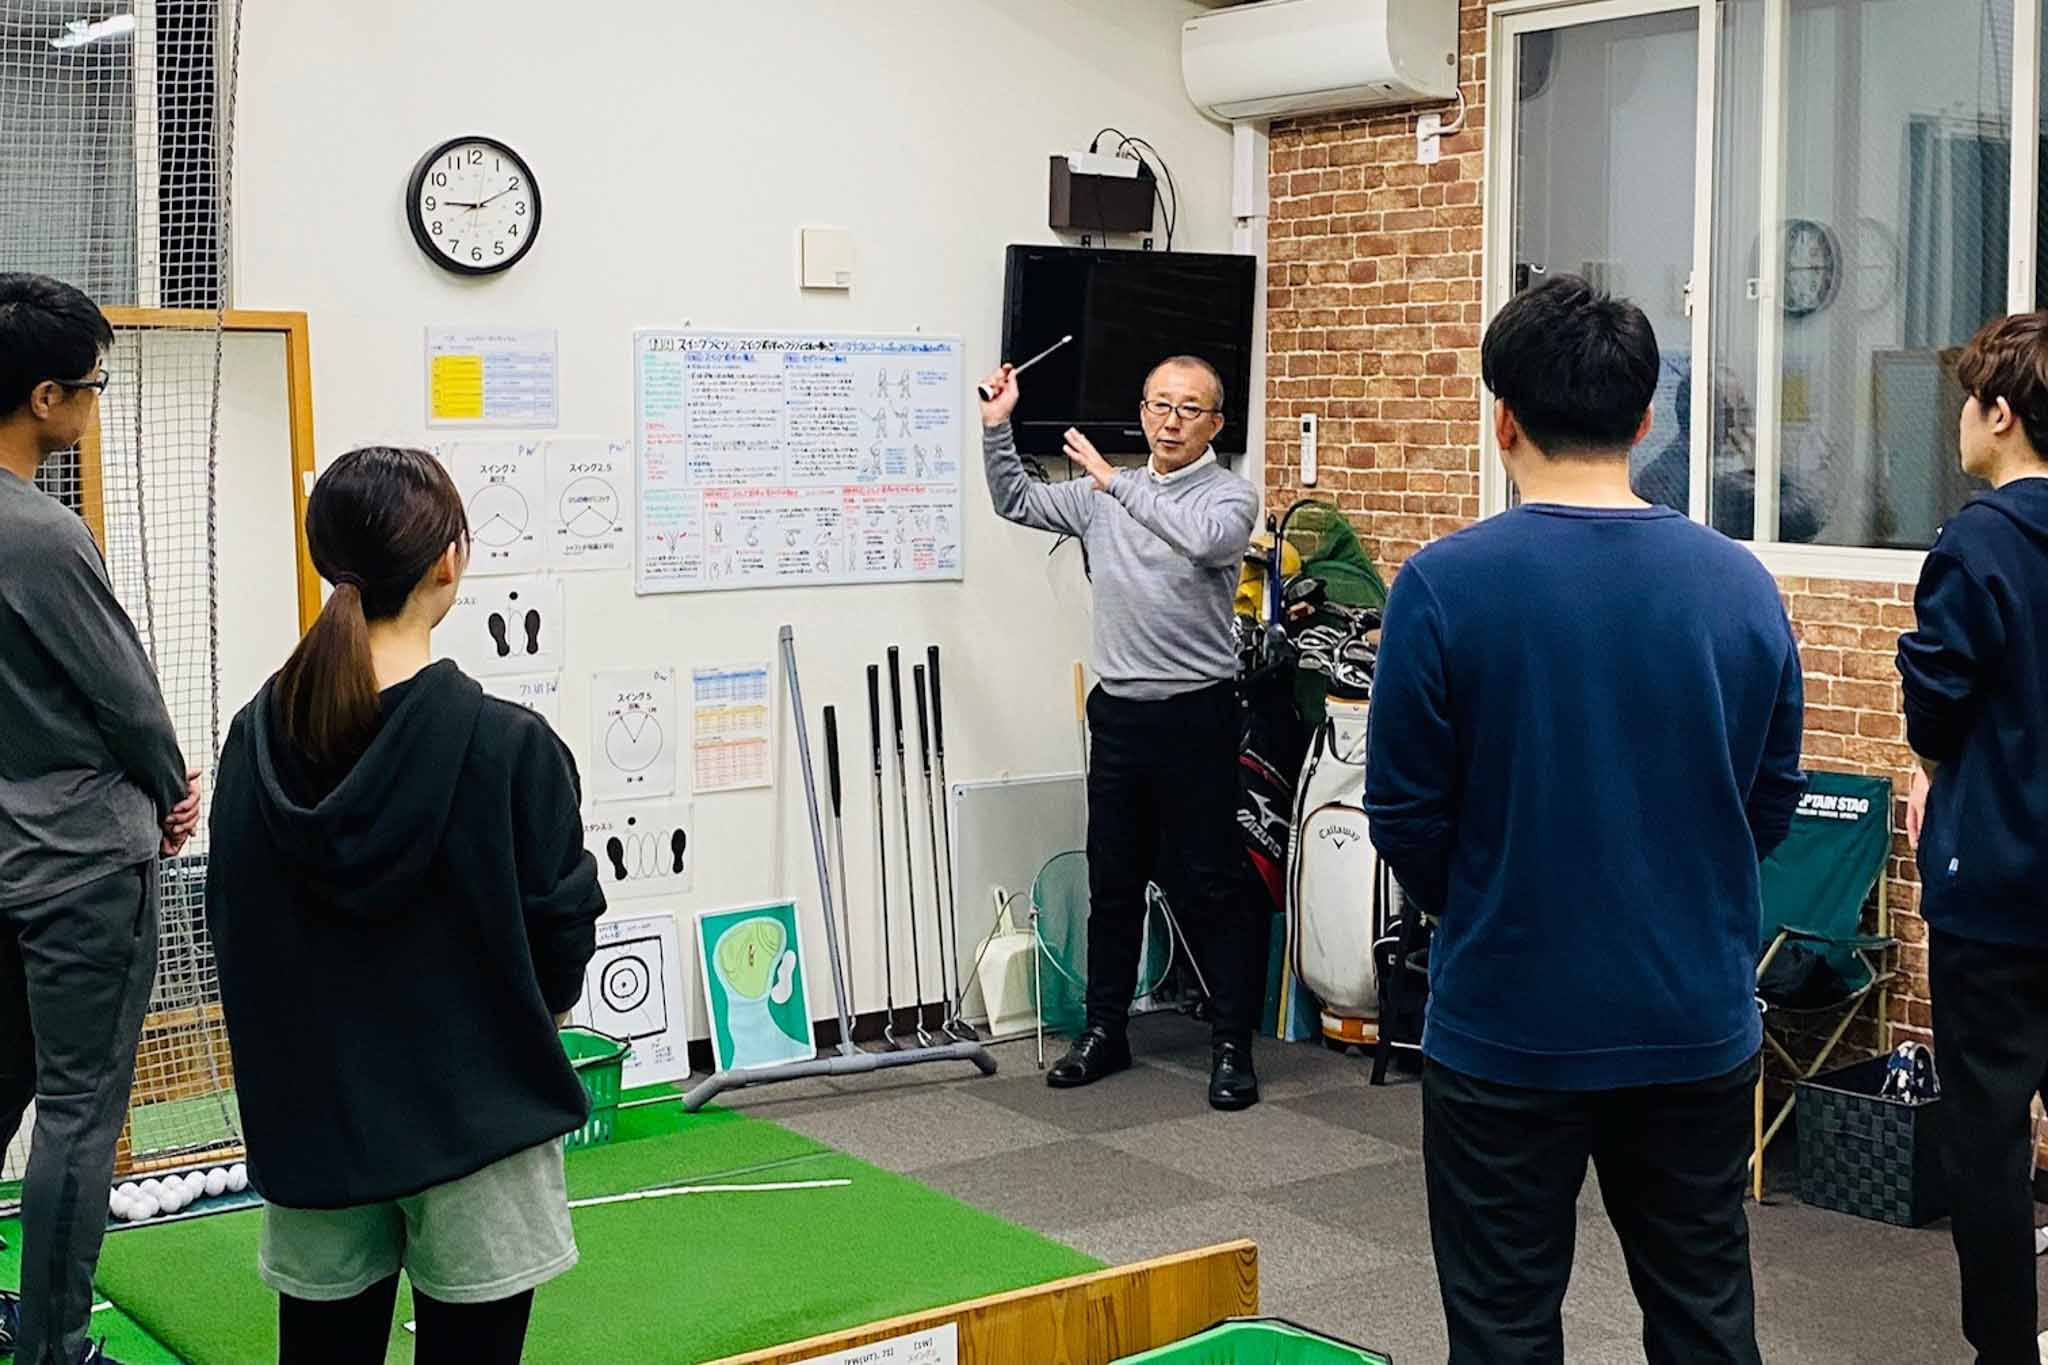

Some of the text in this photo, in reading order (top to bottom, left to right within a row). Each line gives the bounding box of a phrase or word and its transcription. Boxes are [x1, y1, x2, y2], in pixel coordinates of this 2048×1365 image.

[448, 156, 461, 170] 11
[467, 150, 483, 165] 12
[495, 158, 500, 172] 1
[431, 172, 447, 187] 10
[508, 177, 520, 190] 2
[425, 196, 436, 211] 9
[515, 202, 526, 216] 3
[432, 221, 443, 235] 8
[508, 224, 519, 237] 4
[449, 239, 460, 254] 7
[493, 241, 505, 255] 5
[471, 247, 483, 261] 6
[1798, 793, 1870, 813] PTAIN STAG
[1319, 824, 1361, 842] Callaway
